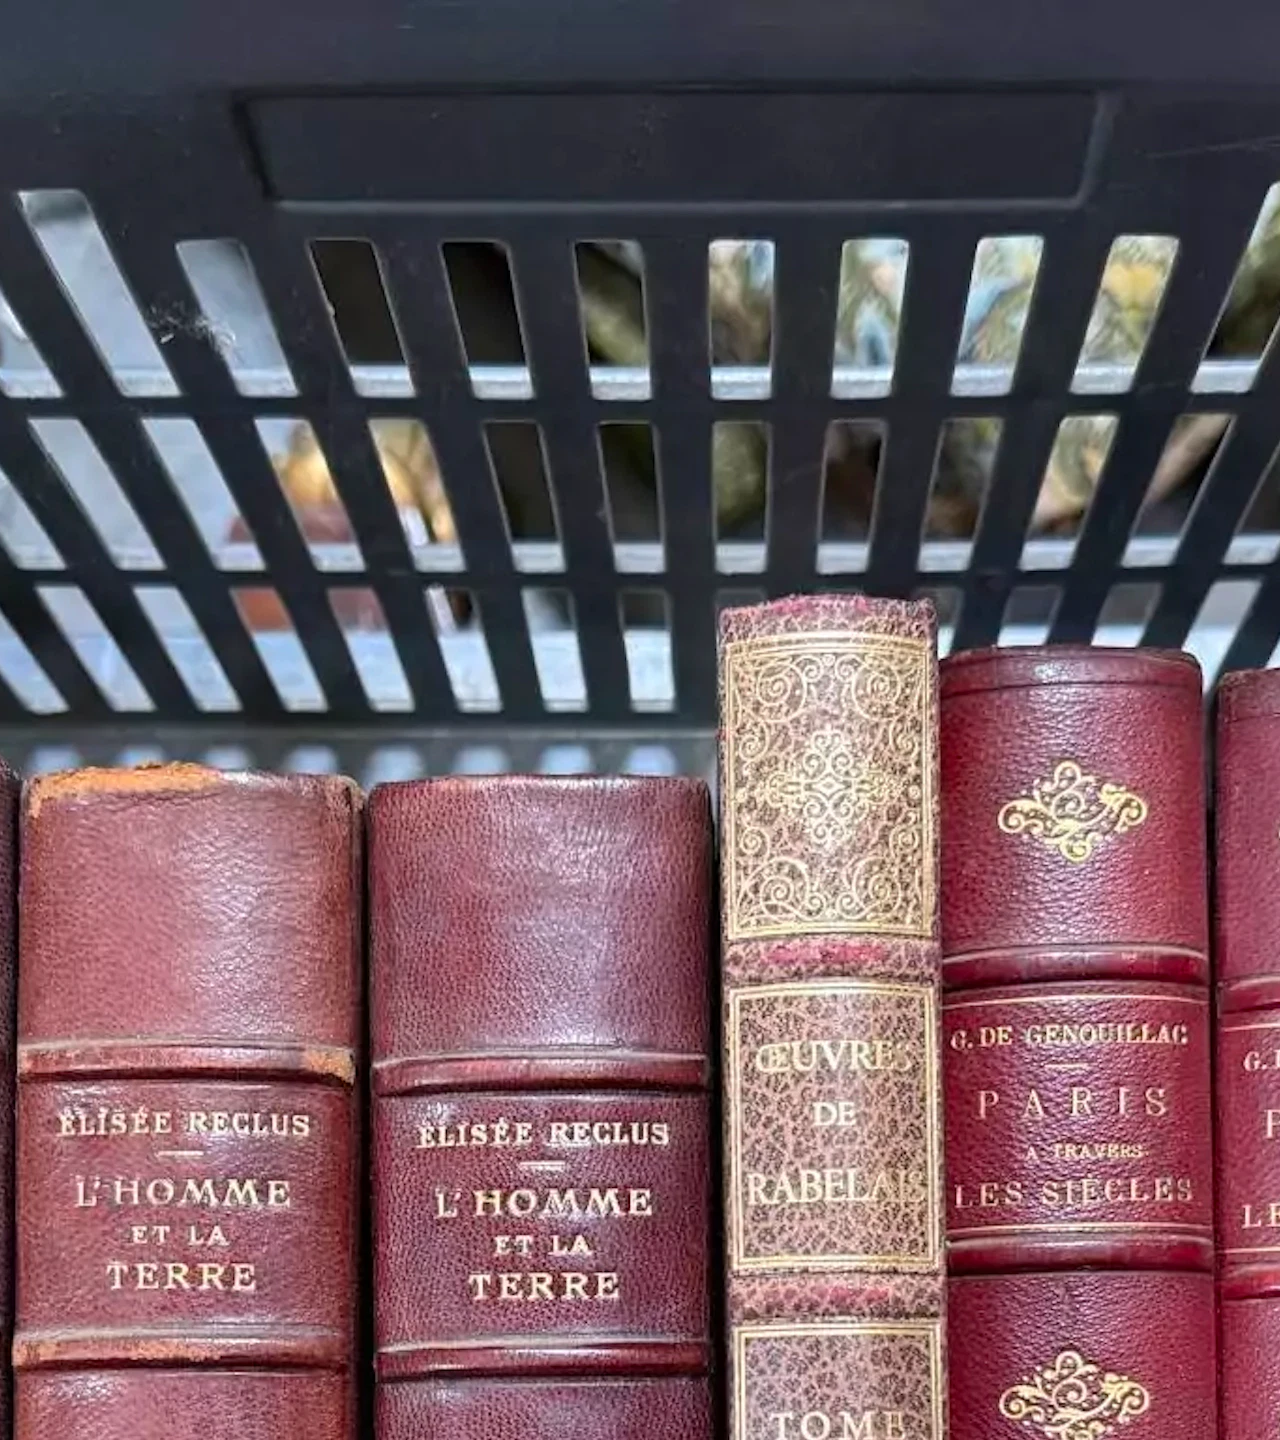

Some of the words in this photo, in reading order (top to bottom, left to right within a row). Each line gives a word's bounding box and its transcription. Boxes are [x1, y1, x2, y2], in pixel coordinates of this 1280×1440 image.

[950, 1031, 973, 1050] G.
[980, 1026, 1013, 1047] DE
[1026, 1023, 1189, 1045] GENOUILLAC
[756, 1040, 911, 1074] ŒUVRES
[1243, 1052, 1267, 1071] G.
[813, 1102, 856, 1126] DE
[977, 1086, 1168, 1120] PARIS
[187, 1111, 310, 1137] RECLUS
[547, 1121, 670, 1147] RECLUS
[1053, 1143, 1144, 1159] TRAVERS
[75, 1179, 290, 1208] L'HOMME
[747, 1168, 927, 1205] RABELAIS
[954, 1180, 1023, 1209] LES
[1042, 1174, 1192, 1205] SIÈCLES
[435, 1188, 653, 1219] L'HOMME
[132, 1226, 171, 1245] ET
[188, 1225, 229, 1246] LA
[493, 1235, 534, 1257] ET
[552, 1235, 593, 1256] LA
[107, 1262, 255, 1291] TERRE
[468, 1274, 619, 1301] TERRE
